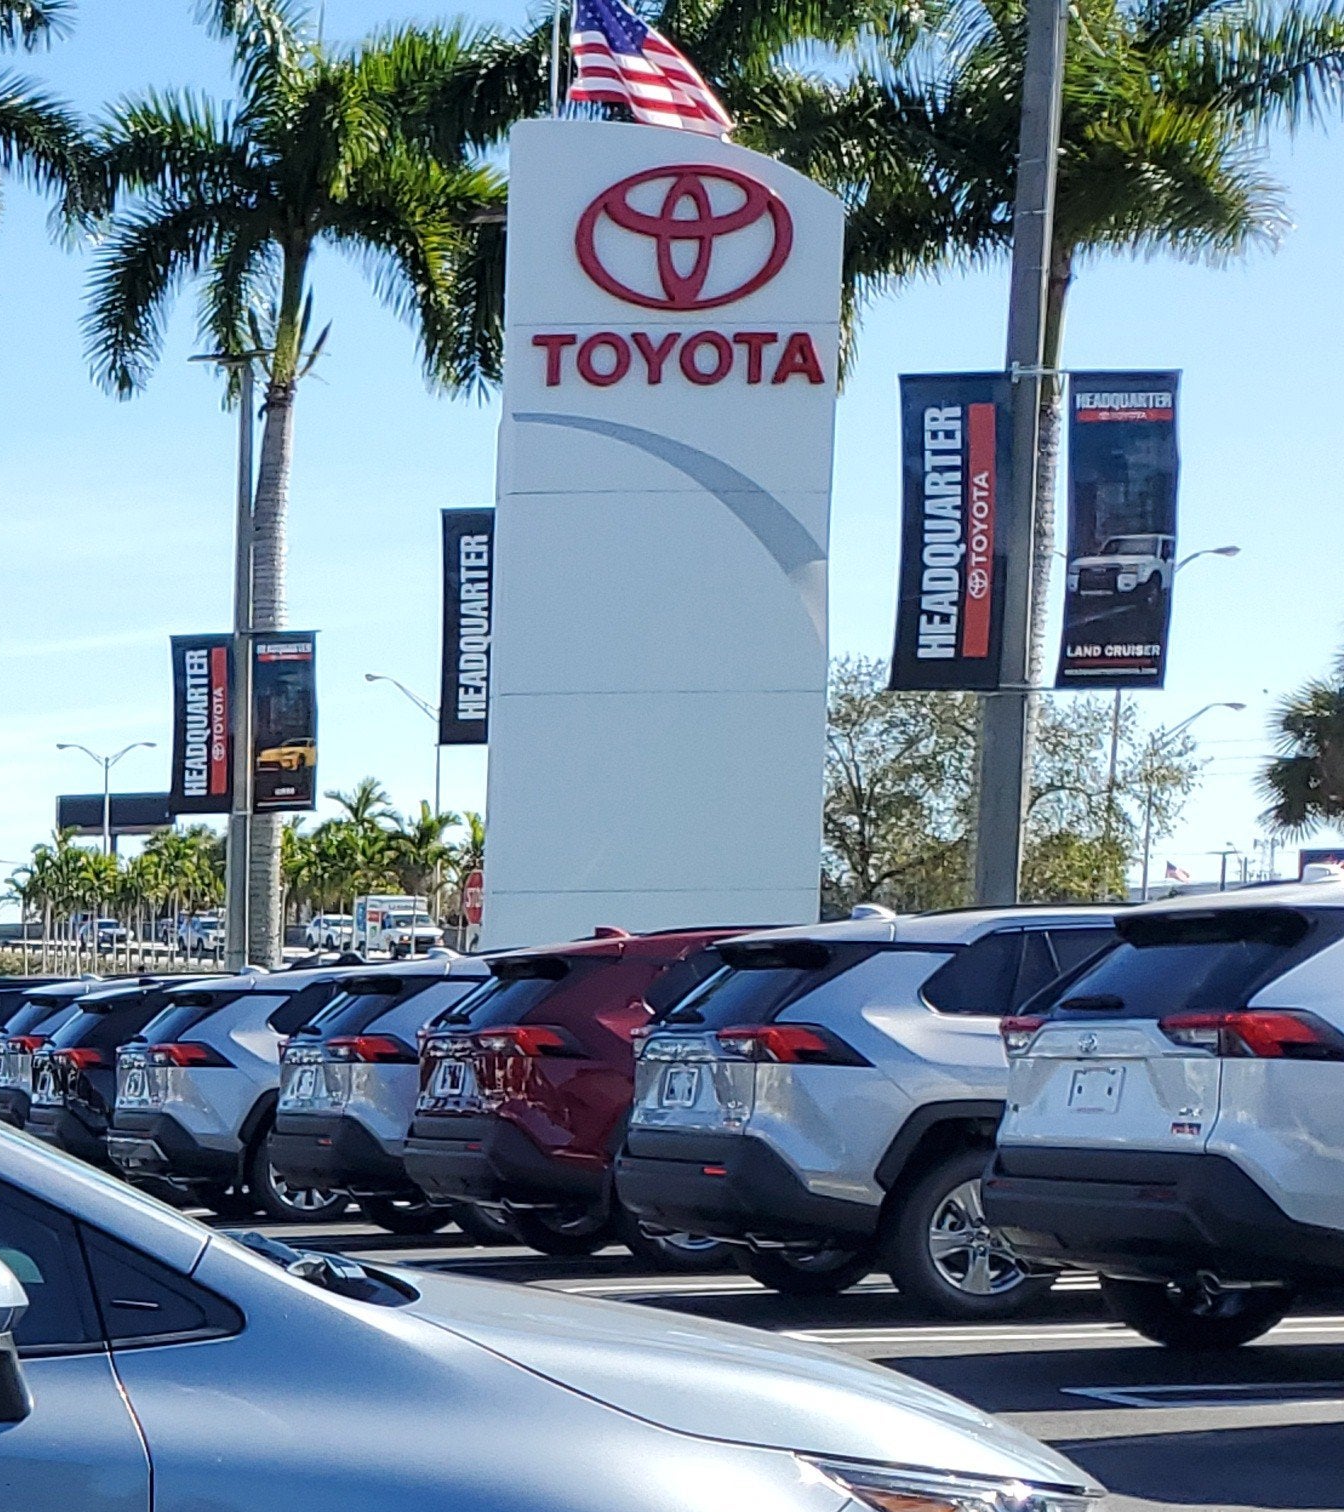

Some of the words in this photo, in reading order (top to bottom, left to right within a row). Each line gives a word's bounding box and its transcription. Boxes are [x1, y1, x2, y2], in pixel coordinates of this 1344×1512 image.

[531, 331, 824, 387] TOYOTA
[917, 404, 966, 659] HEADQUARTER
[971, 471, 990, 568] TOYOTA
[458, 535, 491, 720] HEADQUARTER
[1066, 645, 1102, 657] LAND
[1104, 644, 1161, 657] CRUISER
[184, 649, 211, 796] HEADQUARTER
[213, 687, 224, 743] TOYOTA
